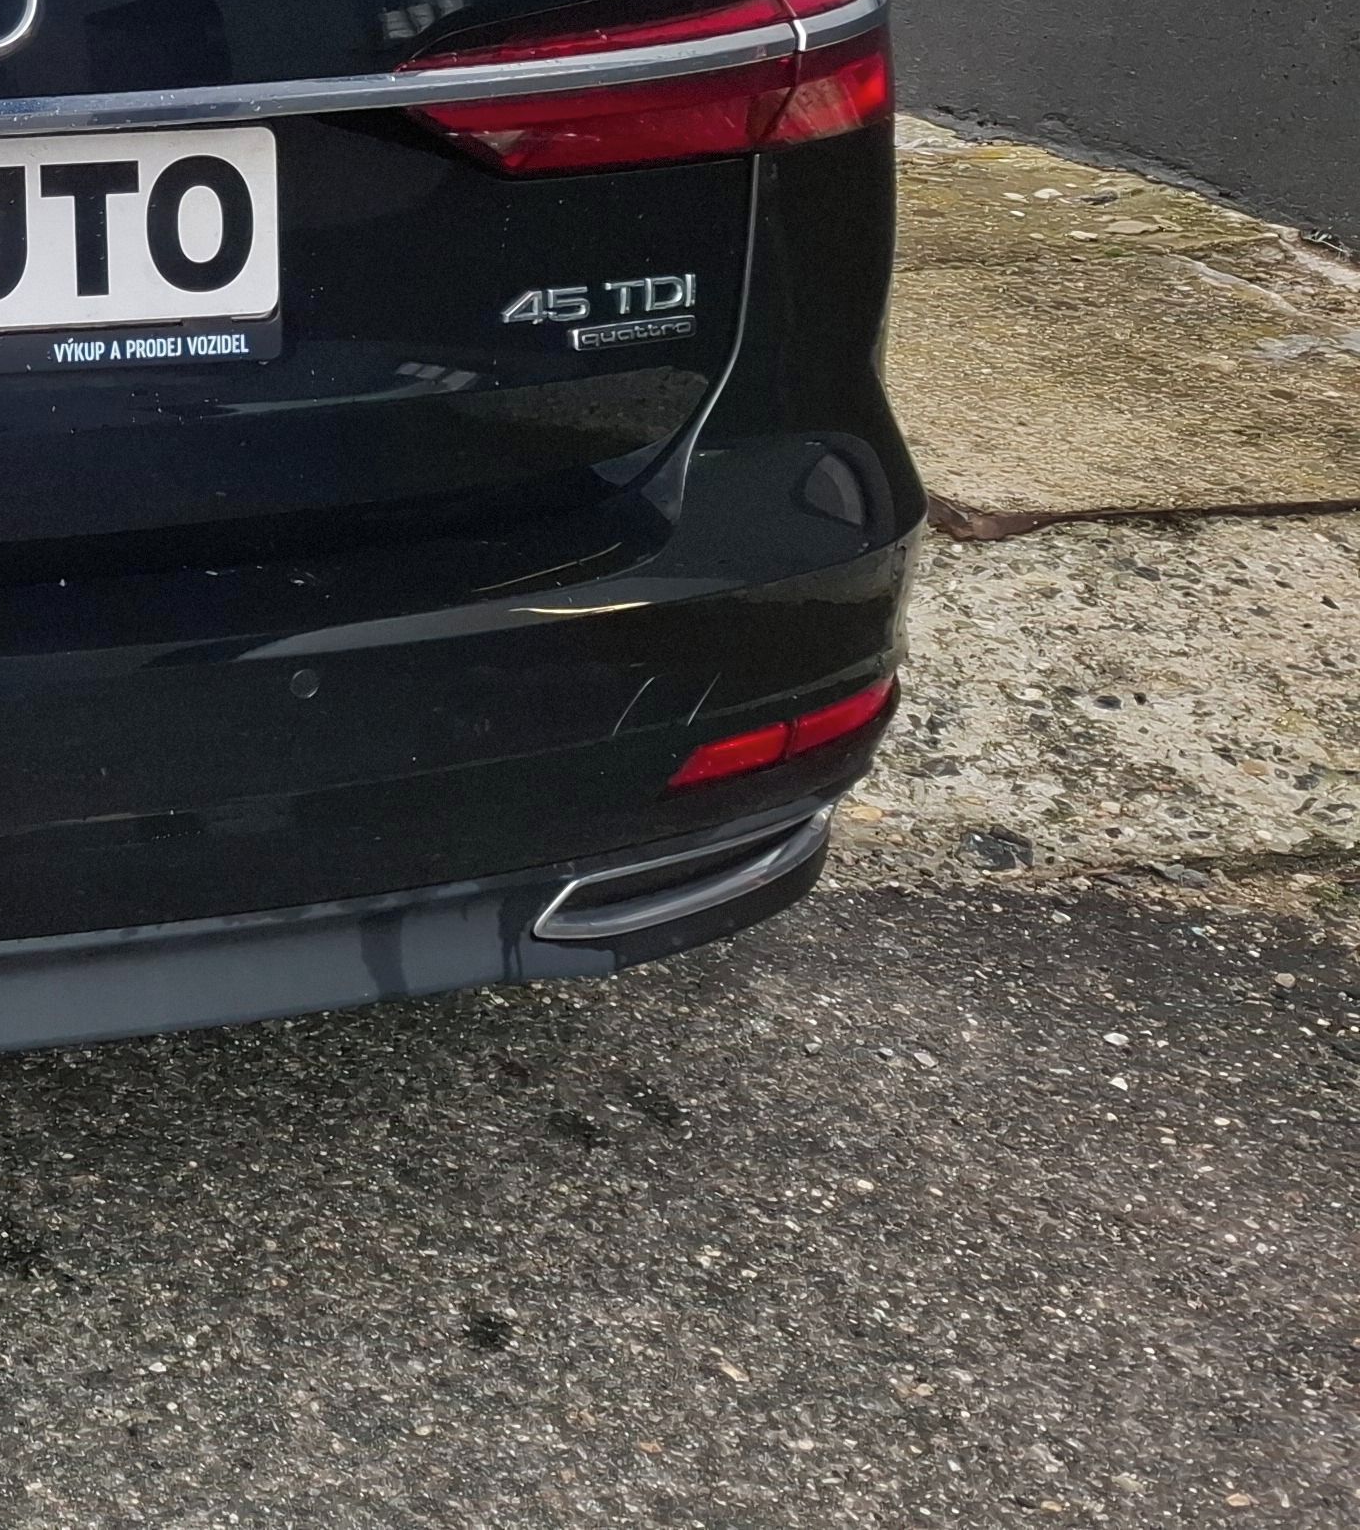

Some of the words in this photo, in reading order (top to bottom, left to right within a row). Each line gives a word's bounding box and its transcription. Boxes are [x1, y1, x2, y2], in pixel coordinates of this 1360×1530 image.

[501, 286, 590, 324] 45
[604, 274, 696, 314] TDI
[581, 321, 692, 346] quattro
[54, 338, 105, 362] VÝKUP
[110, 345, 121, 360] A
[126, 337, 182, 358] PRODEJ
[187, 334, 249, 356] VOZIDEL
